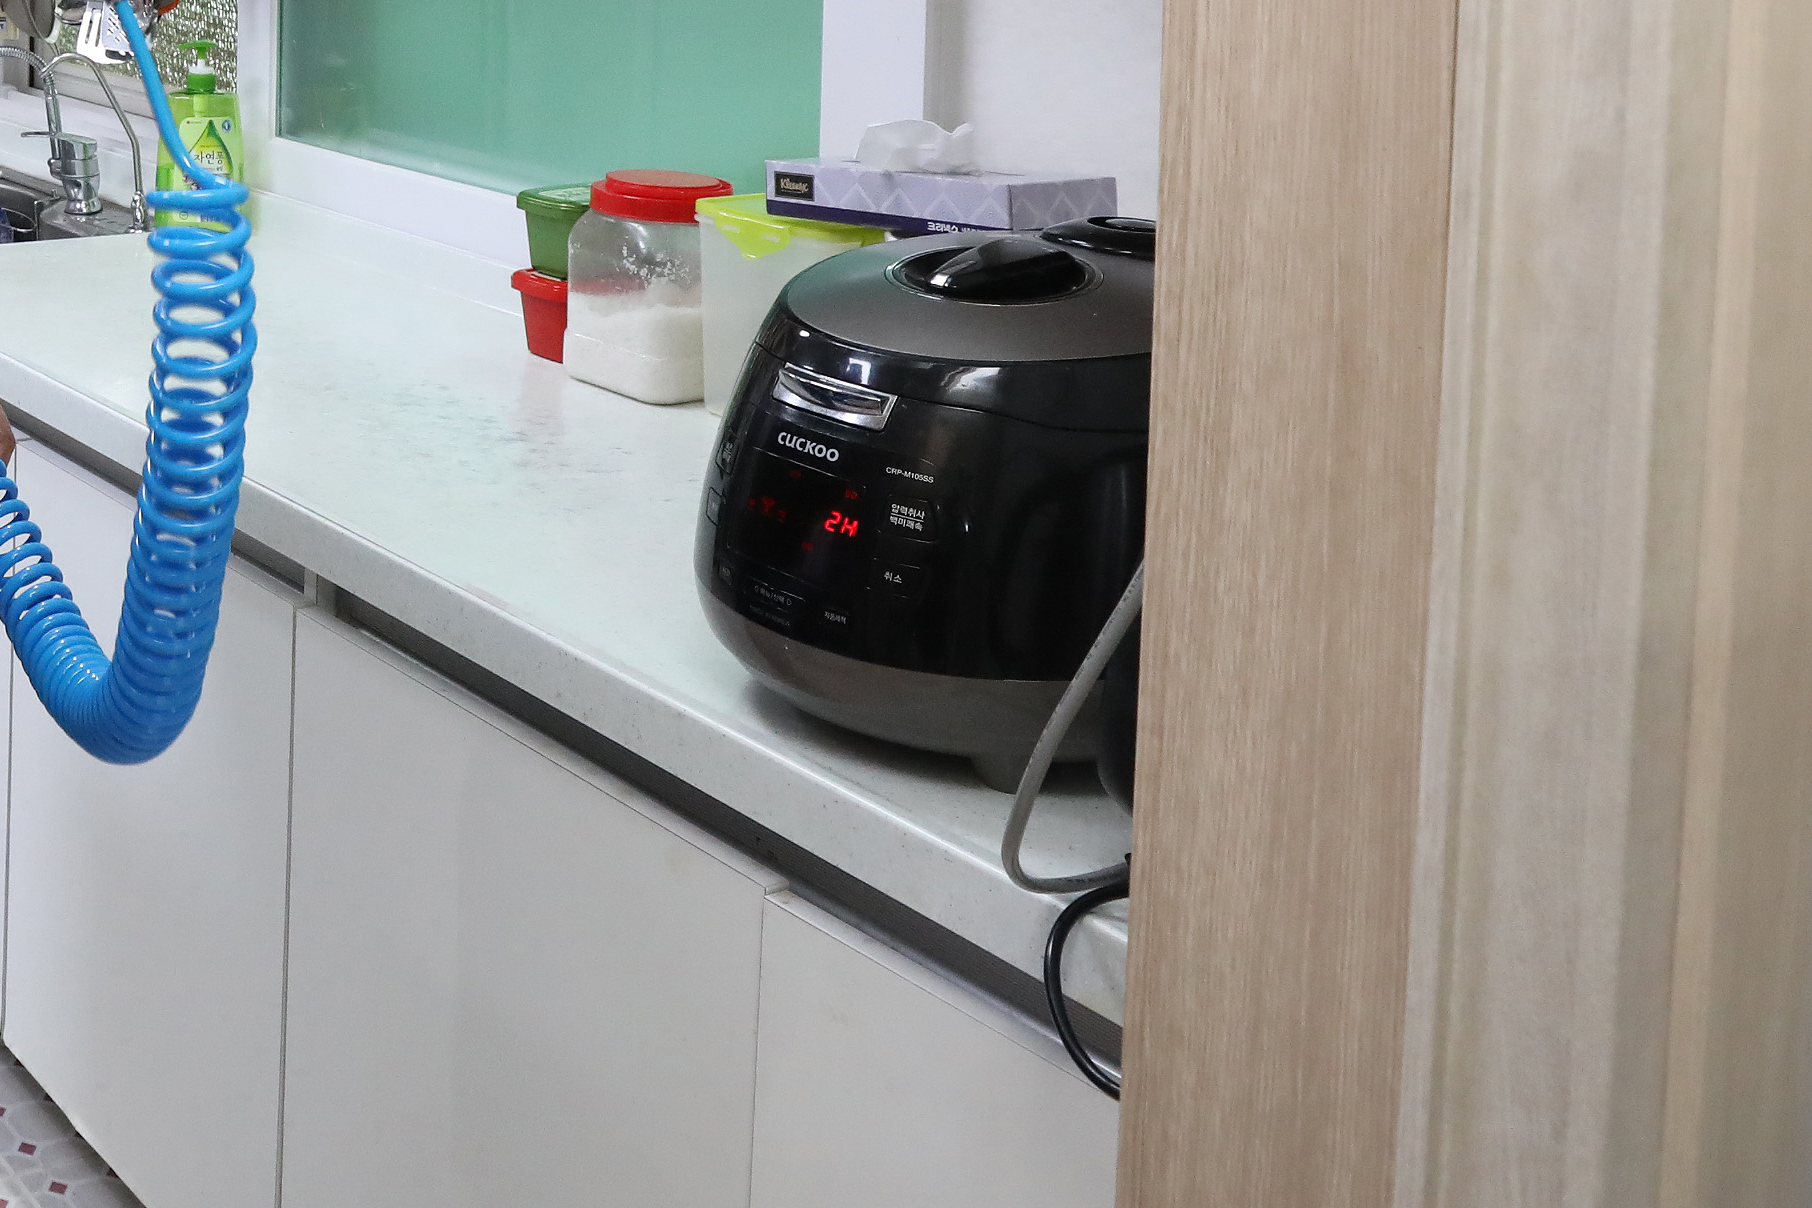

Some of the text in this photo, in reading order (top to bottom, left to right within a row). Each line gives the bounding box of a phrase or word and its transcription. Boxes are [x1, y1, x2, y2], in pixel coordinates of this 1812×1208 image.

[193, 151, 224, 165] 자연퐁
[777, 430, 840, 463] CUCKOO
[885, 466, 935, 483] CRP-M105SS
[890, 503, 926, 519] 압력취사
[823, 510, 860, 537] 2H
[889, 515, 924, 532] 백미쾌속
[883, 570, 903, 584] 취소
